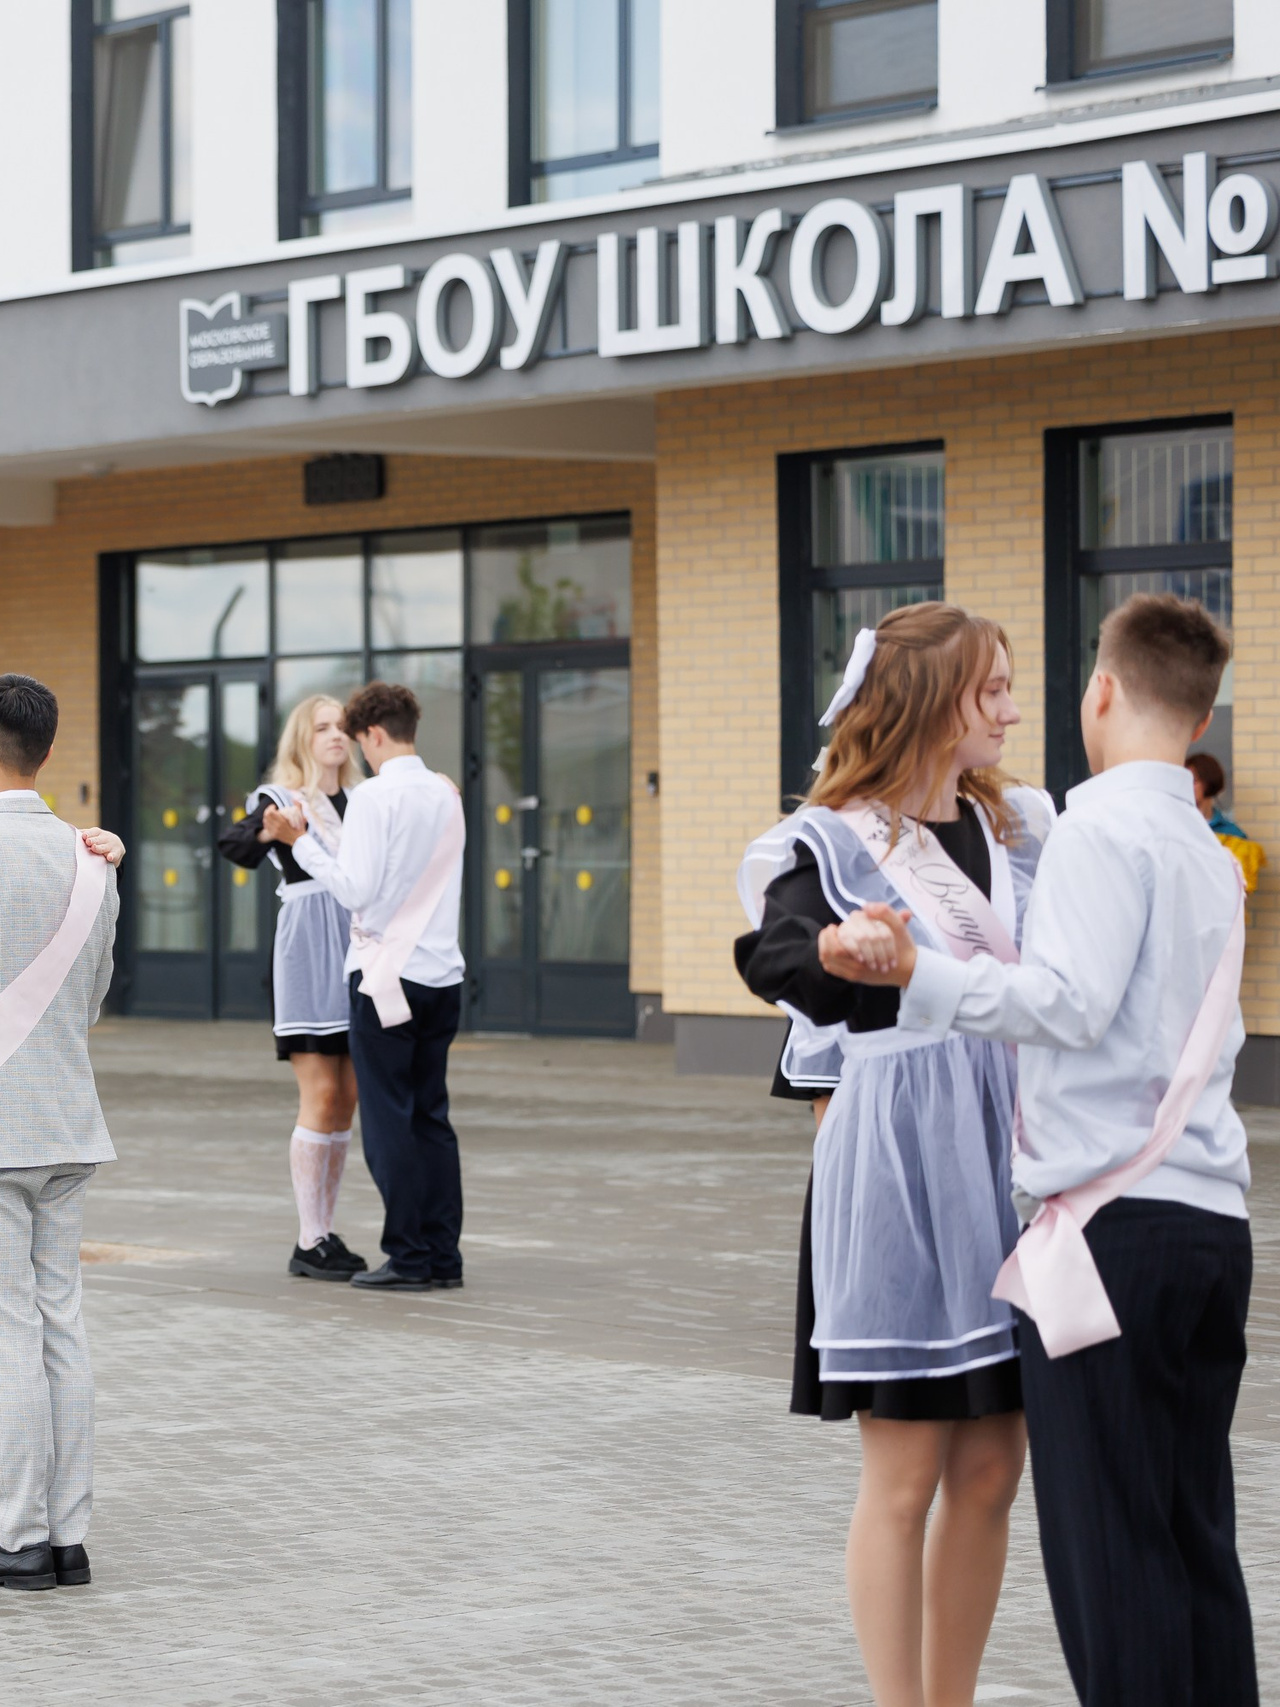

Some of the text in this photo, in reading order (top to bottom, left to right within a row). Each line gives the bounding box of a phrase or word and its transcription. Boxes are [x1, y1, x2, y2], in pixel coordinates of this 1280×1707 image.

[288, 150, 1276, 397] ГБОУ ШКОЛА №
